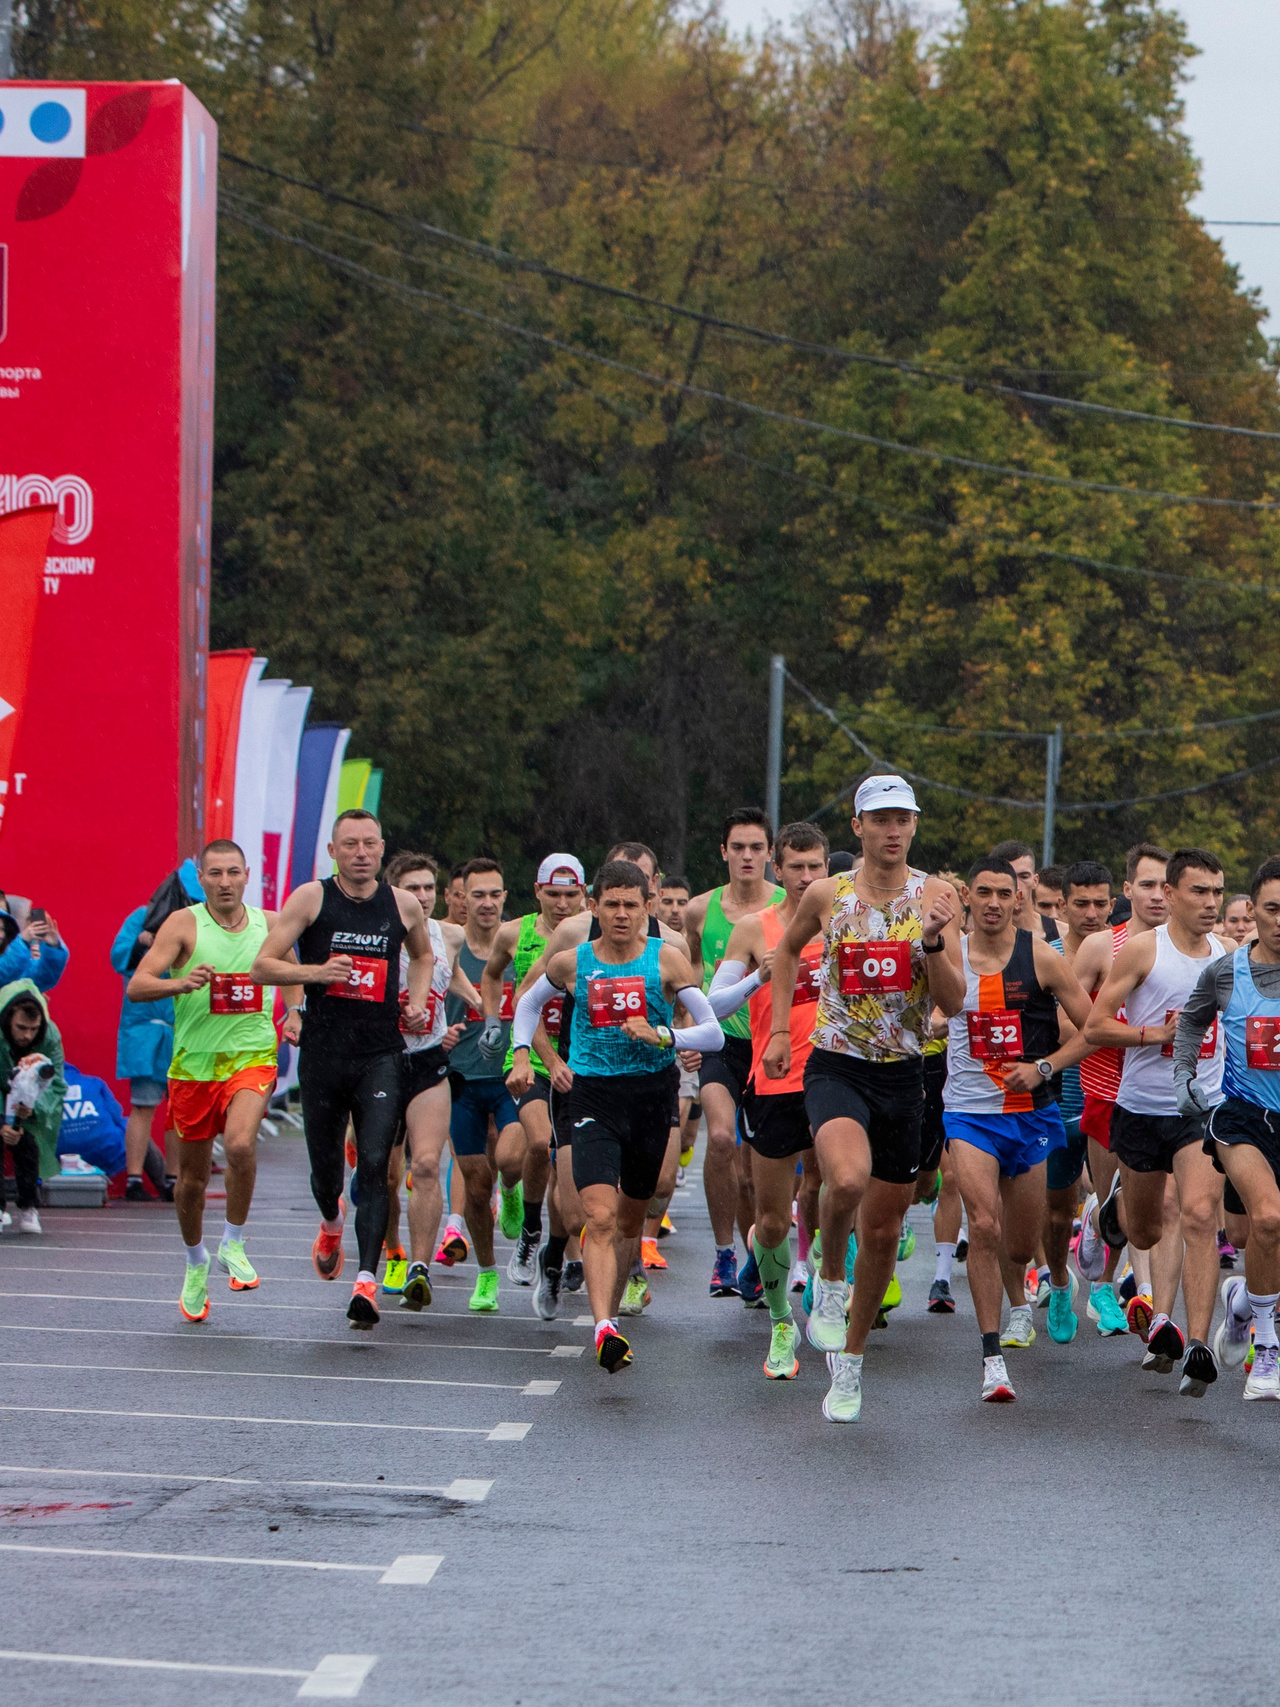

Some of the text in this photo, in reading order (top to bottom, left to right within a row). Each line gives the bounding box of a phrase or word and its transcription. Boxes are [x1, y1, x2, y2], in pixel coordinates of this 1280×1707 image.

[862, 957, 897, 978] 09
[348, 969, 375, 987] 34
[809, 968, 821, 987] 3
[231, 985, 255, 1001] 35
[612, 991, 641, 1011] 36
[990, 1025, 1018, 1044] 32
